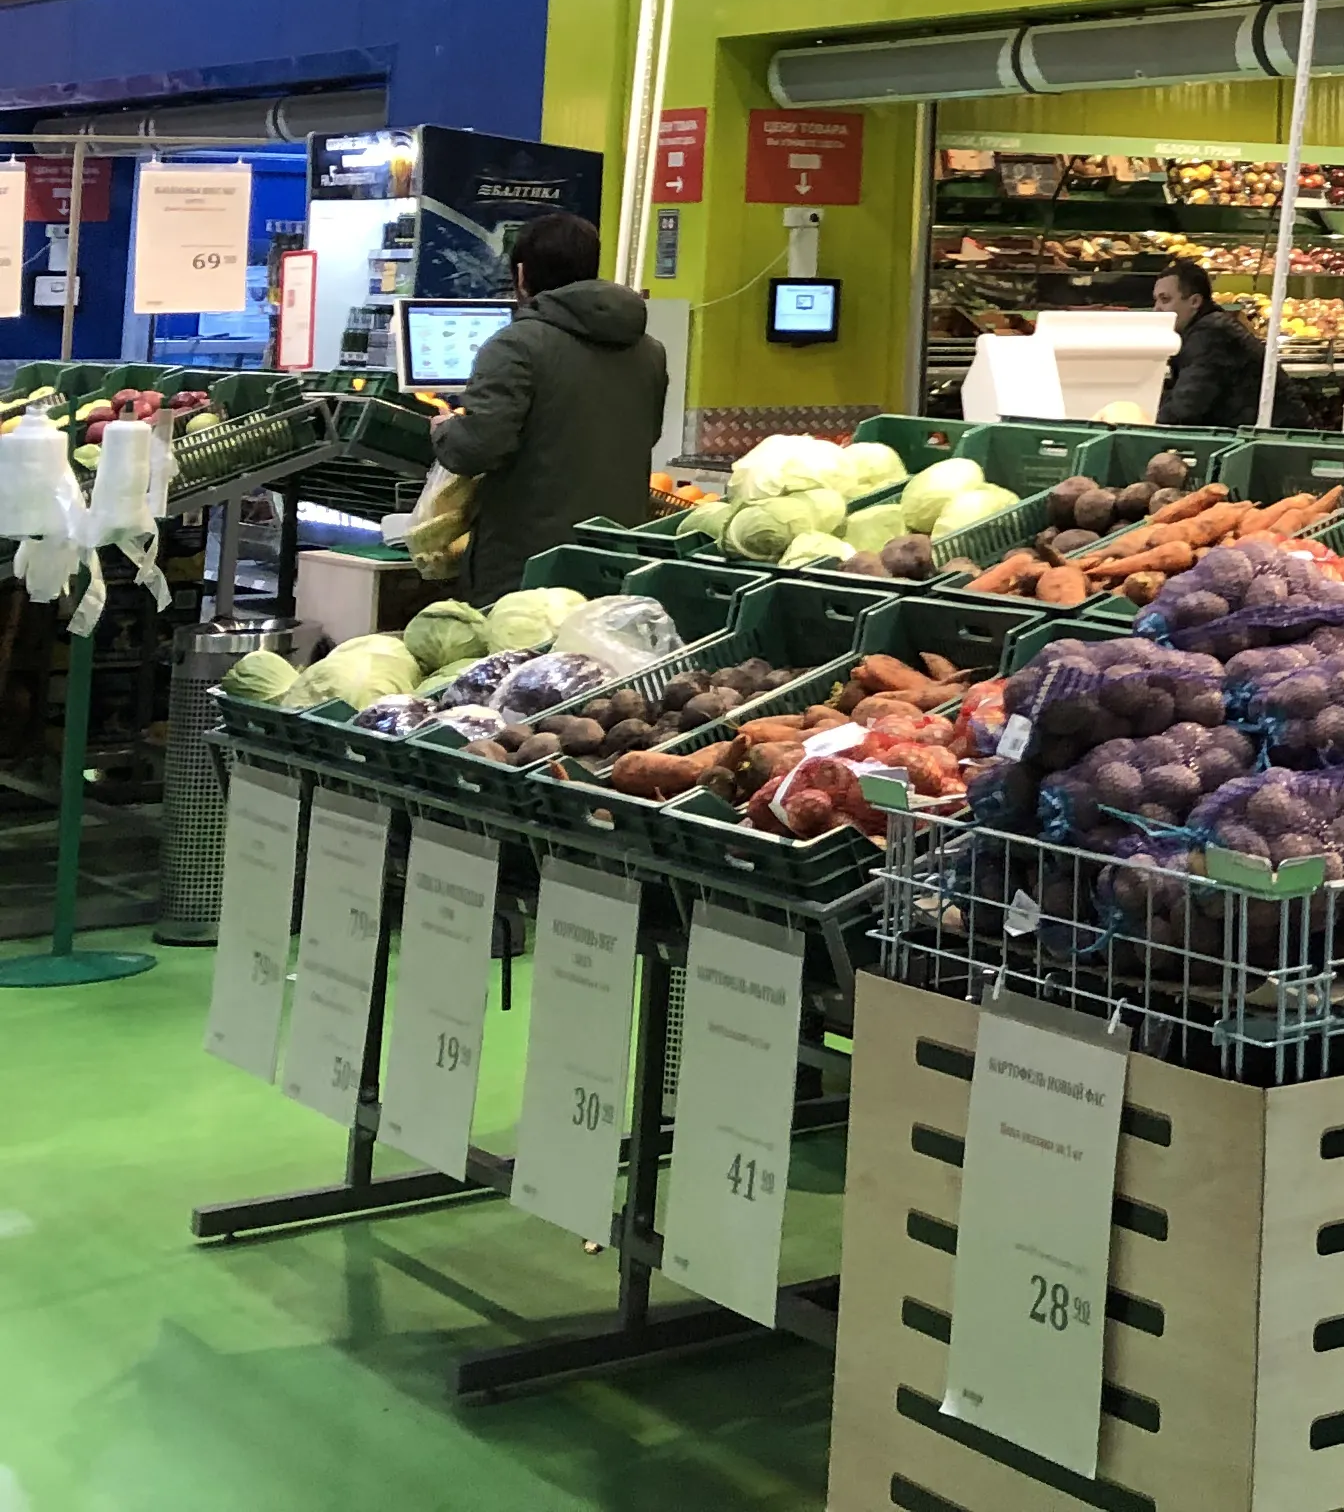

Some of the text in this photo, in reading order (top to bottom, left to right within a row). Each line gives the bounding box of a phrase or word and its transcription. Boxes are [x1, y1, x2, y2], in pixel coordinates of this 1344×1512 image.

[492, 184, 561, 199] БАЛТИКА
[192, 252, 221, 270] 69
[435, 1032, 460, 1072] 19
[988, 1057, 1107, 1107] КАРТОФЕЛЬ НОВЫЙ ФАС
[572, 1086, 600, 1132] 30
[726, 1153, 756, 1202] 41
[1029, 1275, 1069, 1331] 28
